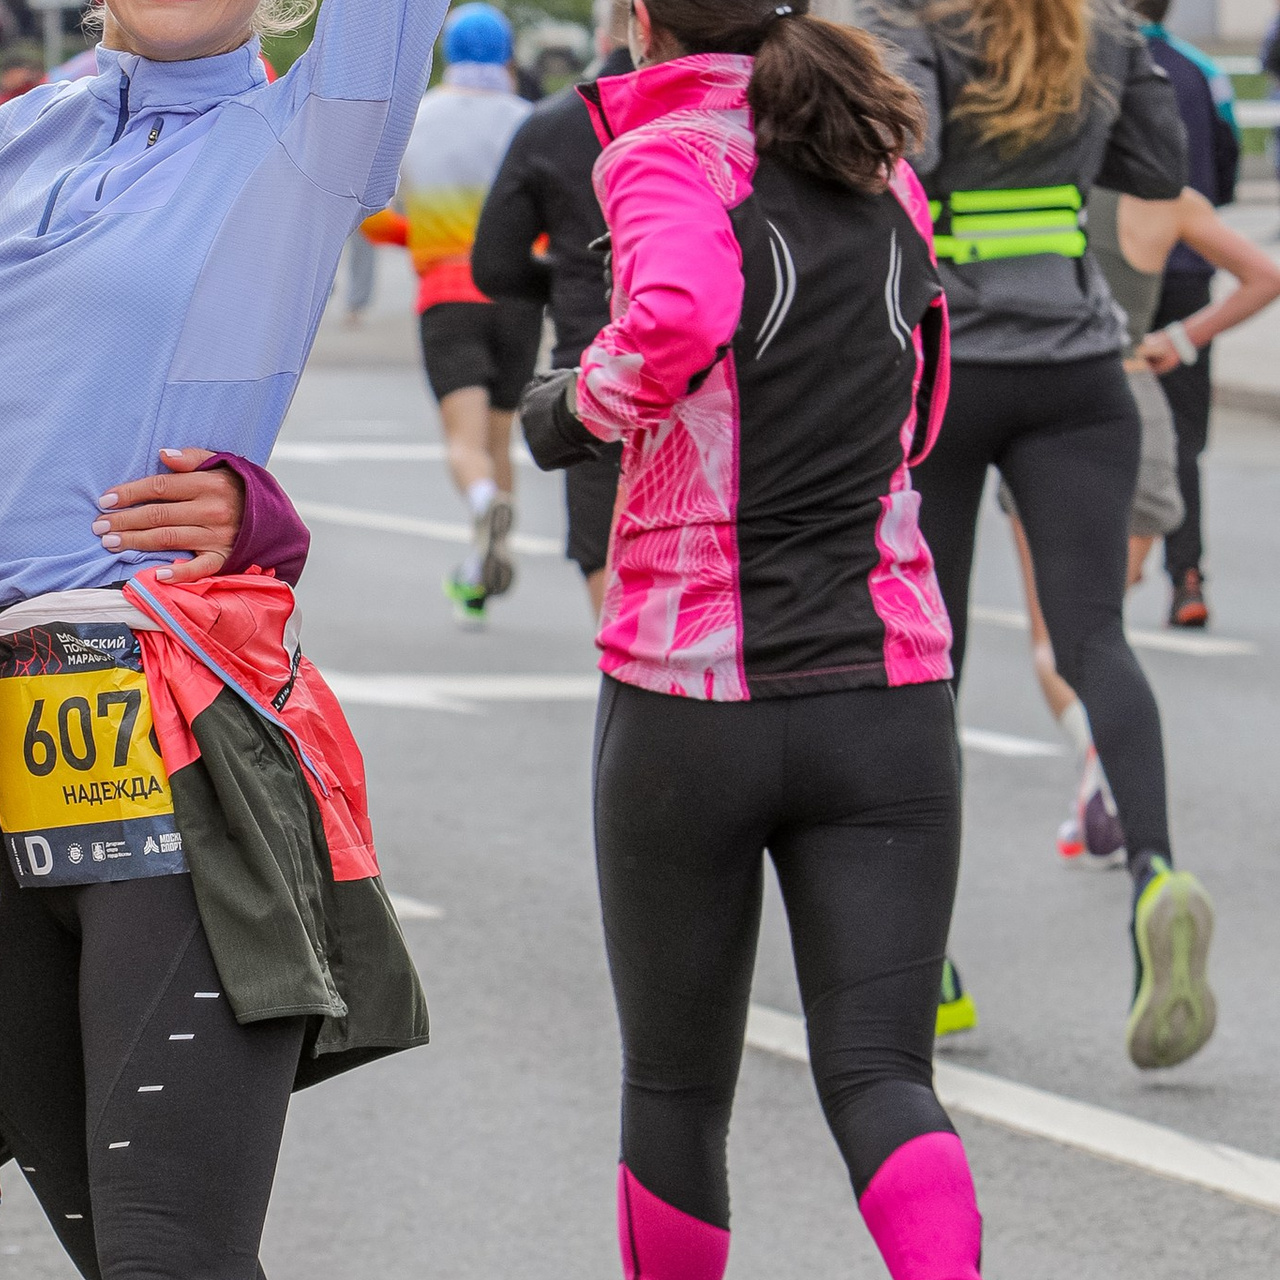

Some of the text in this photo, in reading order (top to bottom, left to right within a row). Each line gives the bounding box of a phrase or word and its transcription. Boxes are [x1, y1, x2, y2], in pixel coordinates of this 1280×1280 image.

[23, 688, 163, 777] 607
[62, 775, 164, 806] НАДЕЖДА
[24, 835, 54, 876] D
